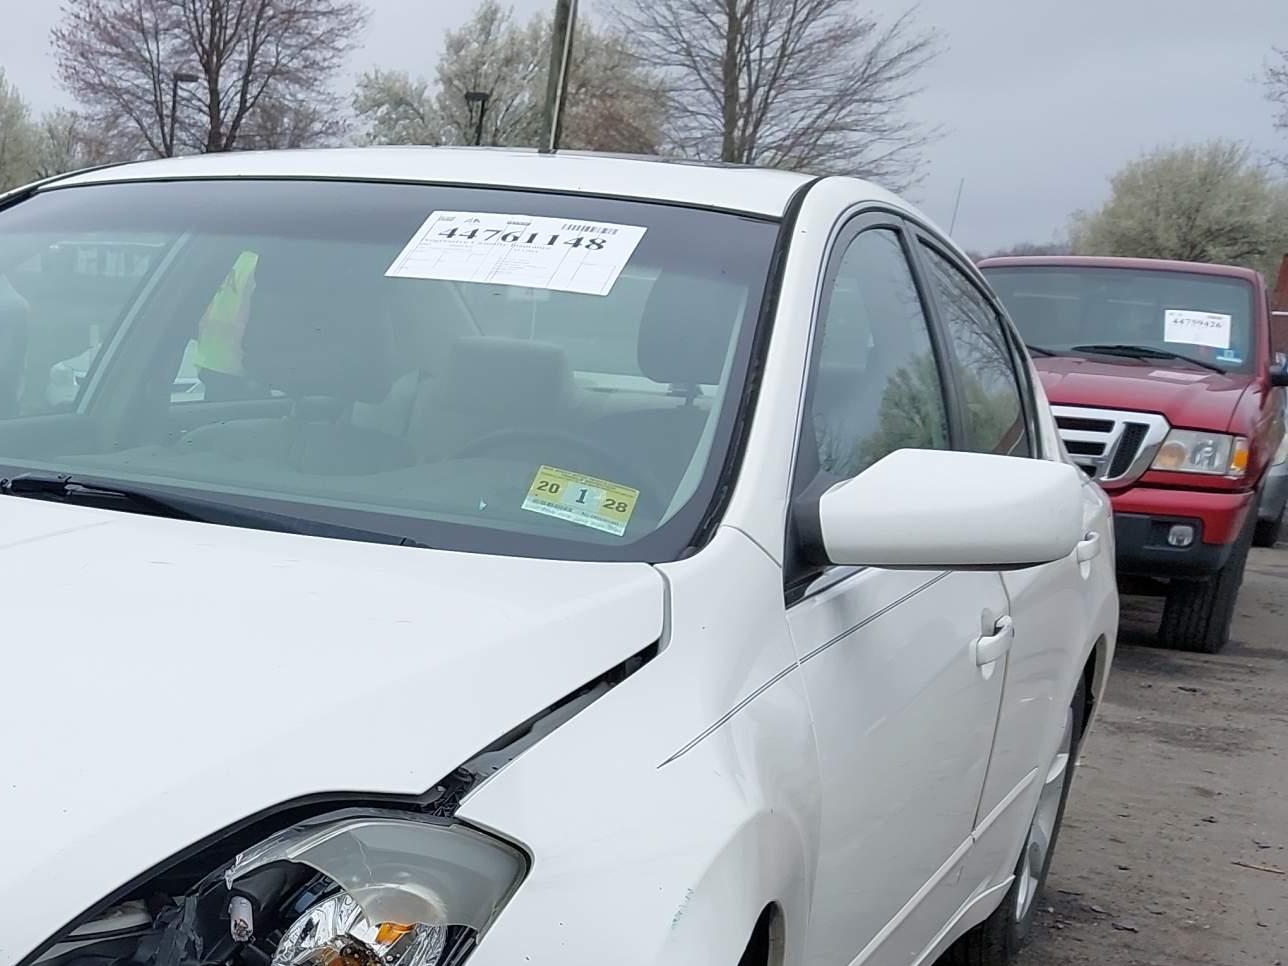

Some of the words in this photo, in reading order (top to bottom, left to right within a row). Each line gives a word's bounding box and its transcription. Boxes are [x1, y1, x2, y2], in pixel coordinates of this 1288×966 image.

[438, 227, 607, 250] 44761148
[536, 480, 560, 494] 20
[575, 488, 588, 504] 1
[602, 498, 628, 513] 28
